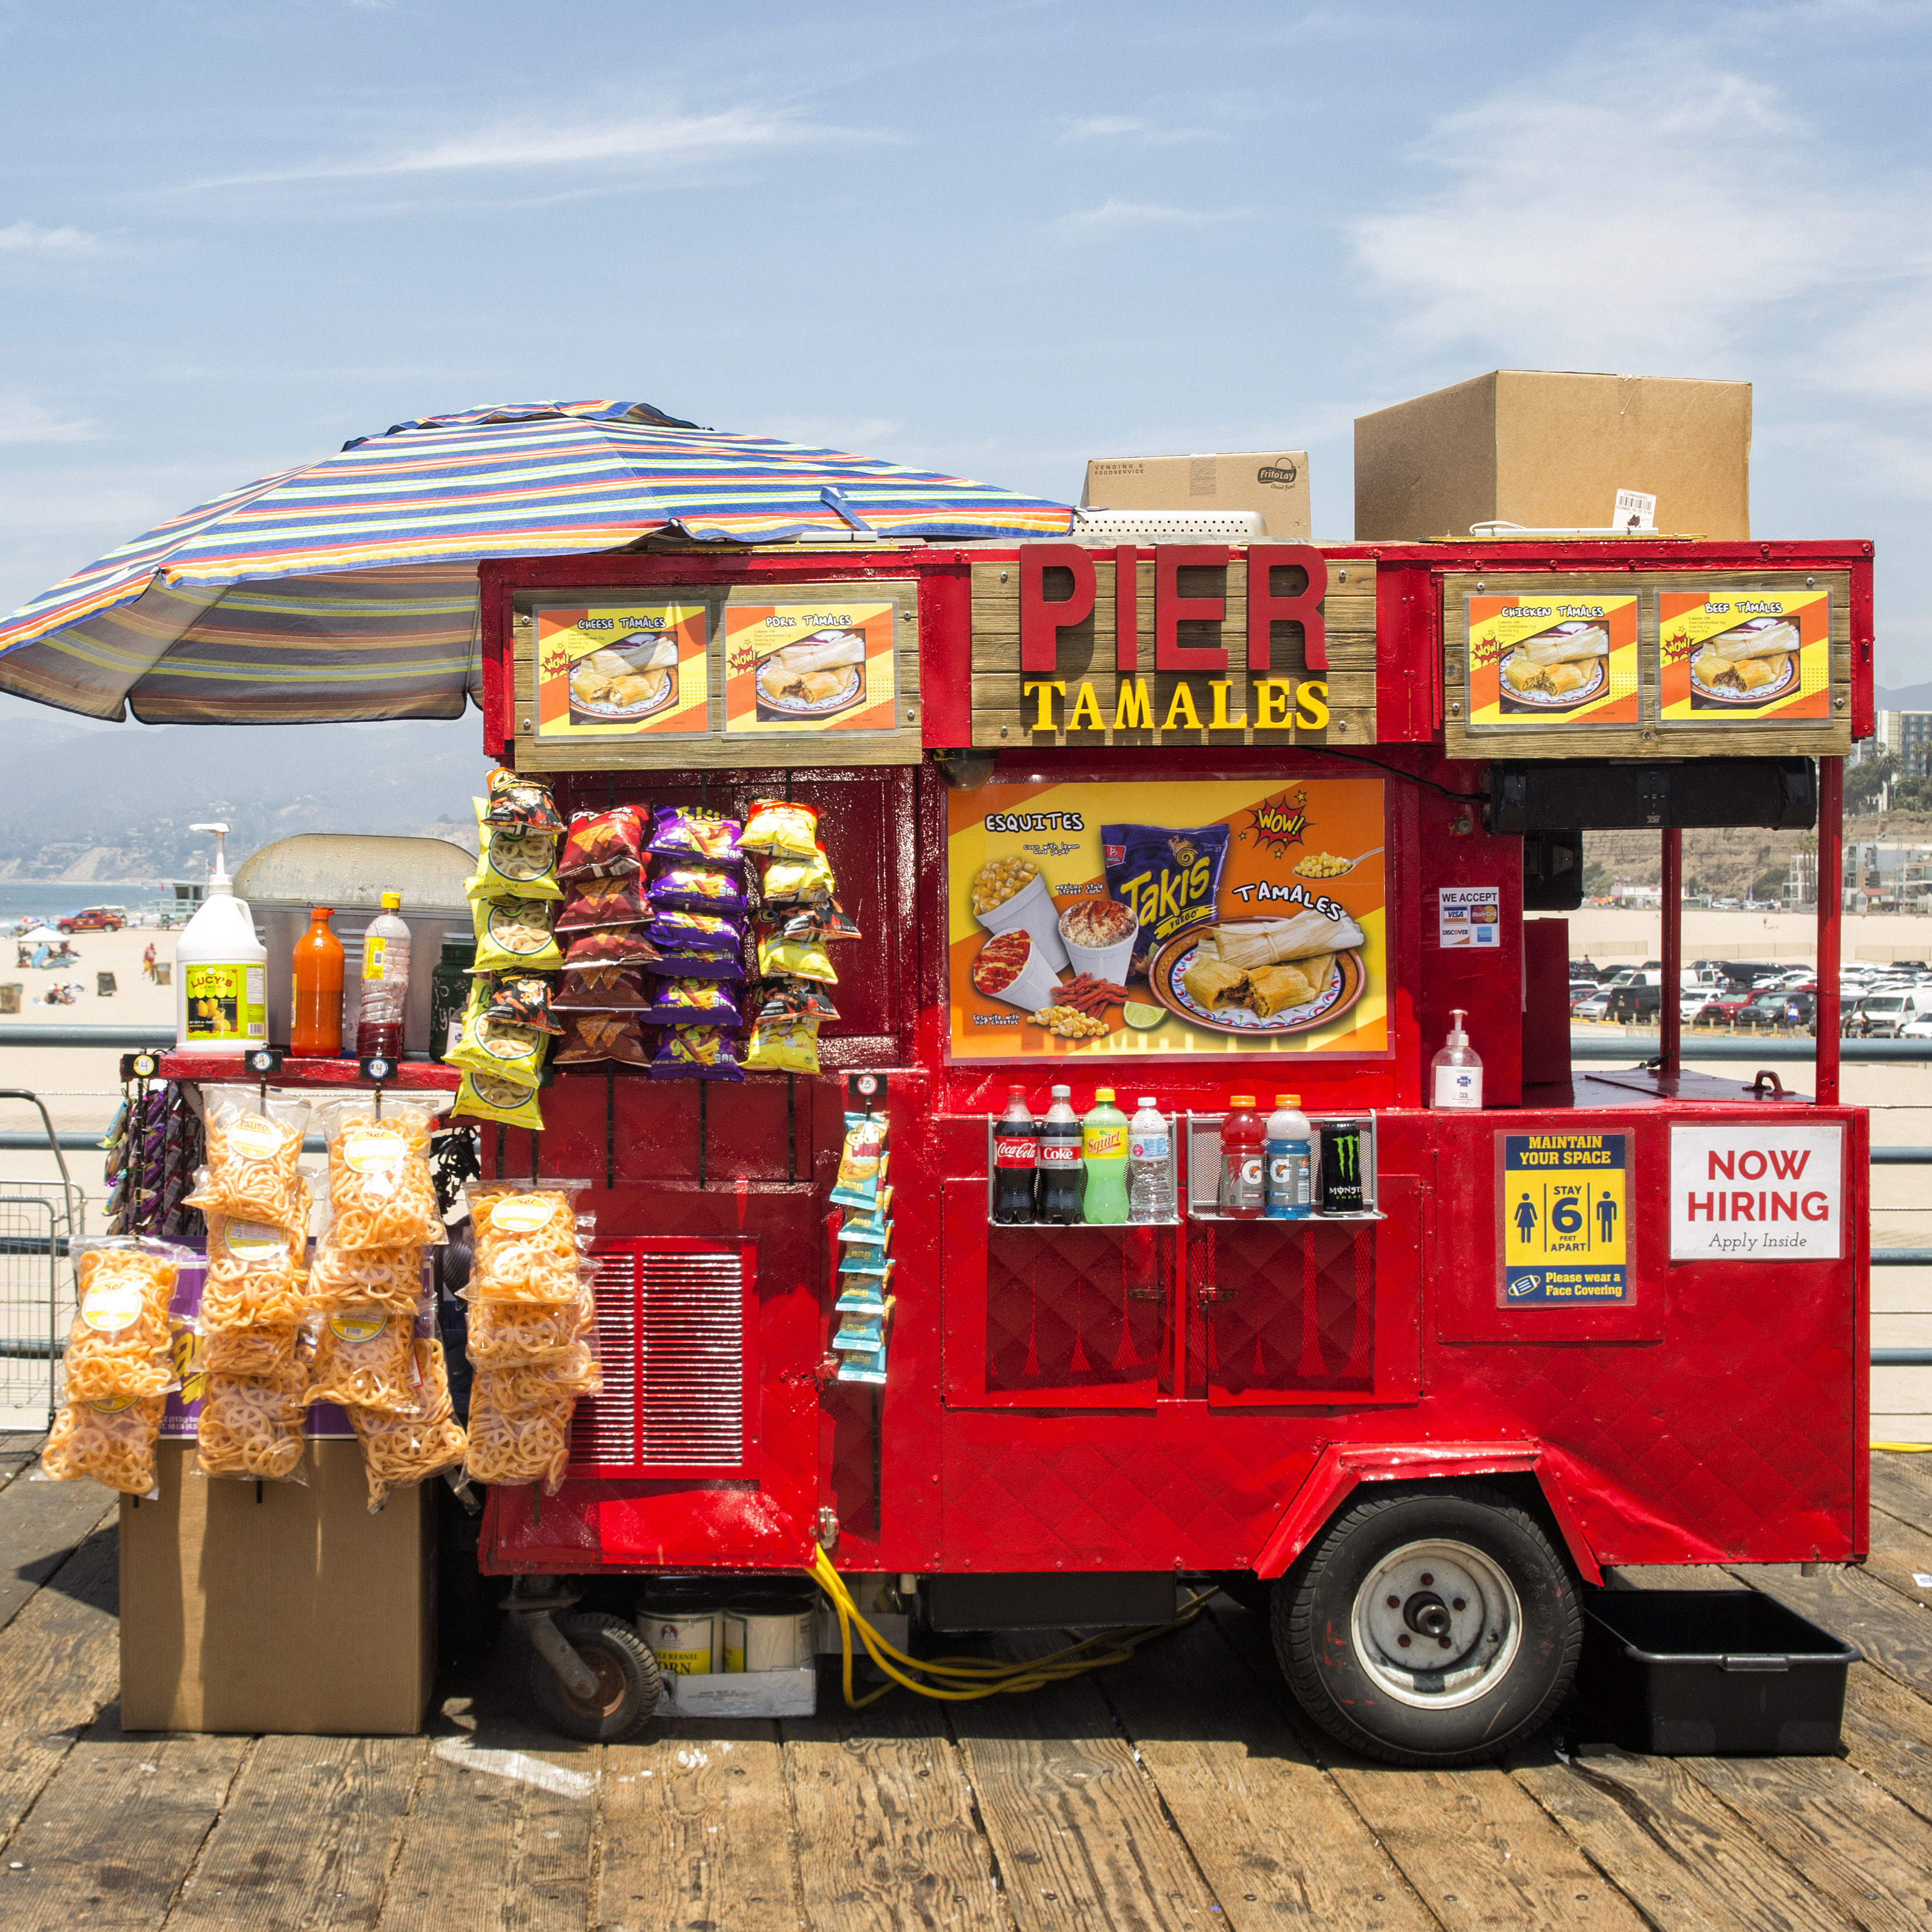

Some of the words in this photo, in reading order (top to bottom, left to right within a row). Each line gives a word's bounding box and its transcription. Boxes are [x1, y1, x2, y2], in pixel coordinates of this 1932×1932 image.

[1020, 543, 1329, 672] PIER
[1501, 607, 1552, 618] CHICKEN
[1557, 605, 1604, 618] TAMALES
[1705, 602, 1730, 614] BEEF
[1735, 601, 1782, 614] TAMALES
[578, 618, 614, 630] CHEESE
[619, 616, 666, 628] TAMALES
[766, 616, 796, 627] PORK
[802, 614, 852, 626] TAMALES
[1474, 640, 1500, 657] WOW!
[1664, 638, 1691, 653] WOW!
[544, 653, 569, 670] WOW!
[730, 650, 756, 666] WOW!
[1024, 678, 1329, 731] TAMALES
[985, 811, 1085, 833] ESQUITES
[1258, 808, 1304, 835] WOW!
[1086, 881, 1105, 891] style
[1232, 880, 1342, 922] TAMALES
[1442, 894, 1457, 902] WE
[1459, 892, 1498, 902] ACCEPT
[1170, 910, 1197, 929] FUEGO
[191, 976, 233, 988] LUCY'S
[1005, 1012, 1020, 1020] with
[1088, 1130, 1120, 1154] Squirt
[1529, 1134, 1603, 1149] MAINTAIN
[997, 1142, 1037, 1158] Coca-Cola
[1044, 1147, 1073, 1160] Coke
[1519, 1151, 1561, 1166] YOUR
[1563, 1149, 1611, 1165] SPACE
[1242, 1159, 1262, 1185] G
[1270, 1158, 1290, 1183] G
[1708, 1149, 1812, 1181] NOW
[1553, 1185, 1582, 1197] STAY
[1687, 1190, 1830, 1223] HIRING
[1551, 1197, 1583, 1234] 6
[1550, 1242, 1587, 1253] APART
[1708, 1232, 1758, 1252] Apply
[1762, 1232, 1808, 1248] Inside
[1545, 1272, 1582, 1284] Please
[1584, 1274, 1610, 1283] wear
[1612, 1275, 1621, 1283] a
[1545, 1284, 1568, 1297] Face
[1570, 1283, 1623, 1298] Covering
[657, 1661, 692, 1674] ORN
